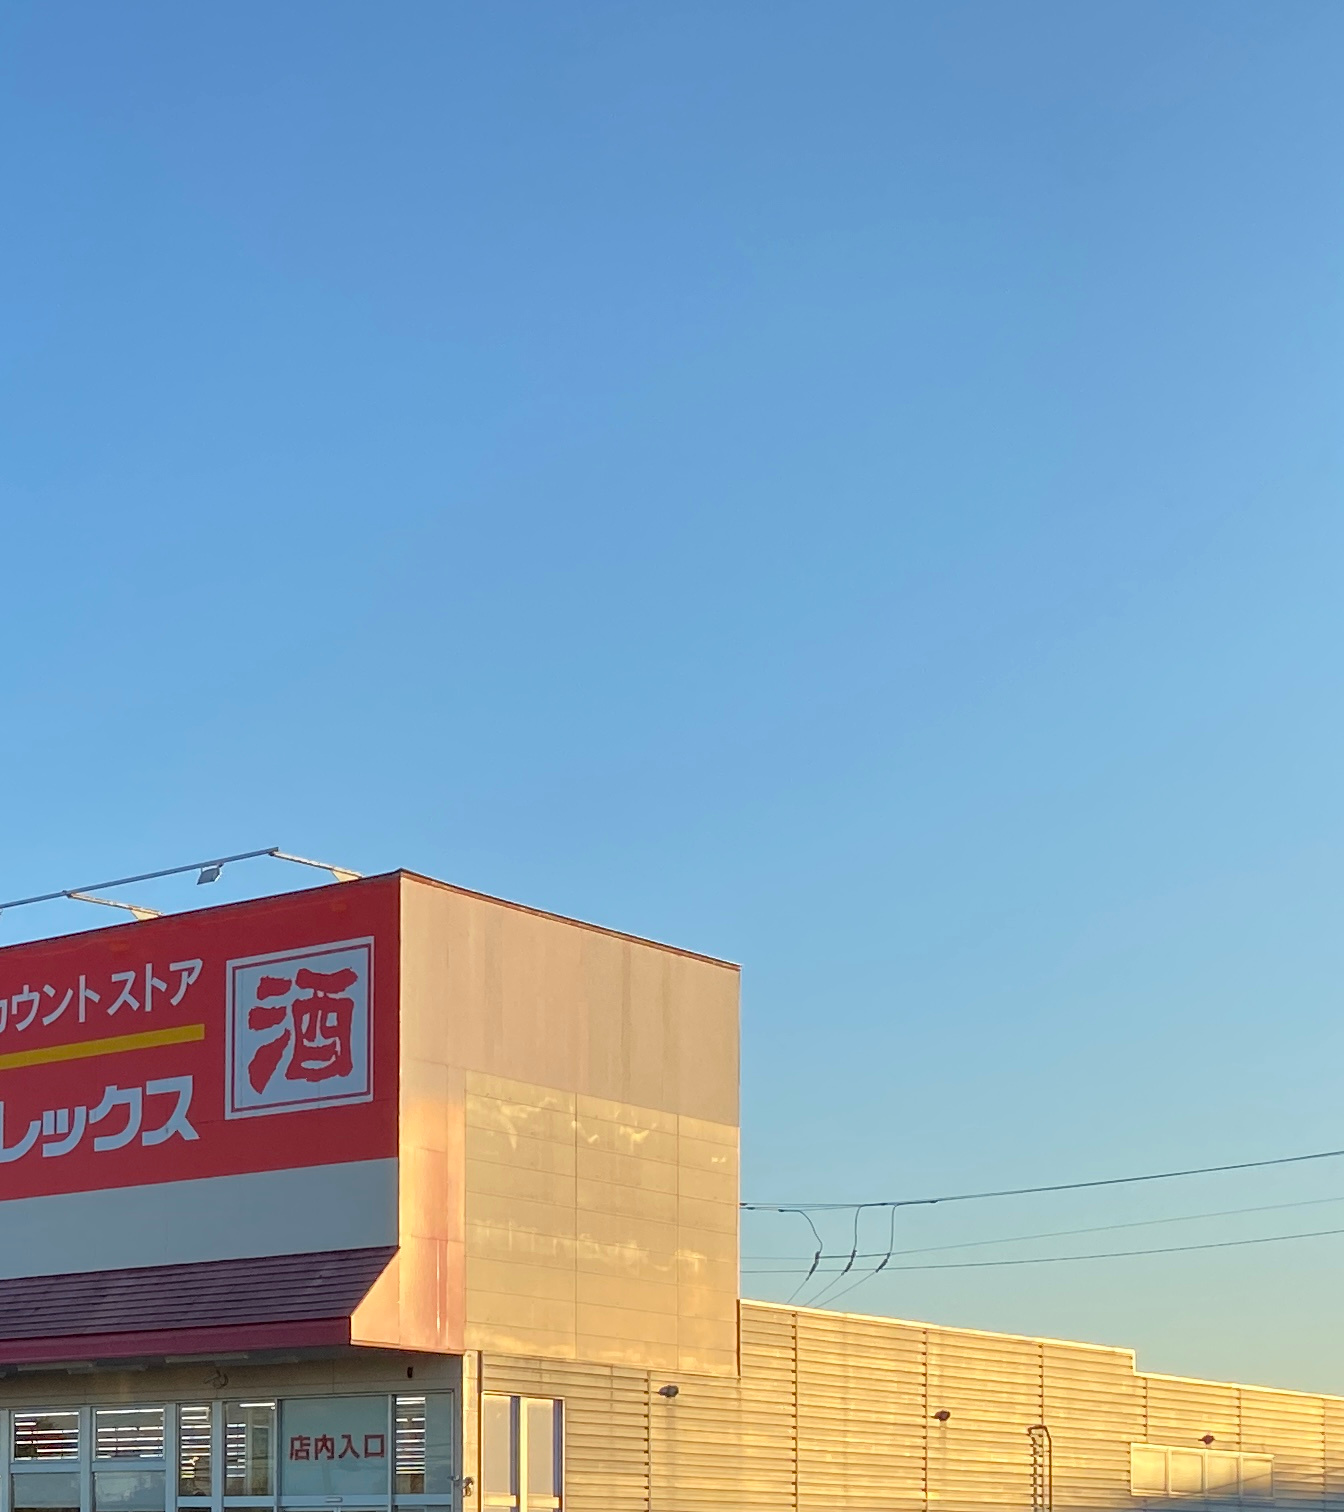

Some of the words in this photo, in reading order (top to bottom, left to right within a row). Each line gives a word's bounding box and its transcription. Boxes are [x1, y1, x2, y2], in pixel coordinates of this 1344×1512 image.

[107, 958, 203, 1016] ストア
[248, 967, 359, 1095] 酒
[289, 1433, 385, 1461] 店内入口
